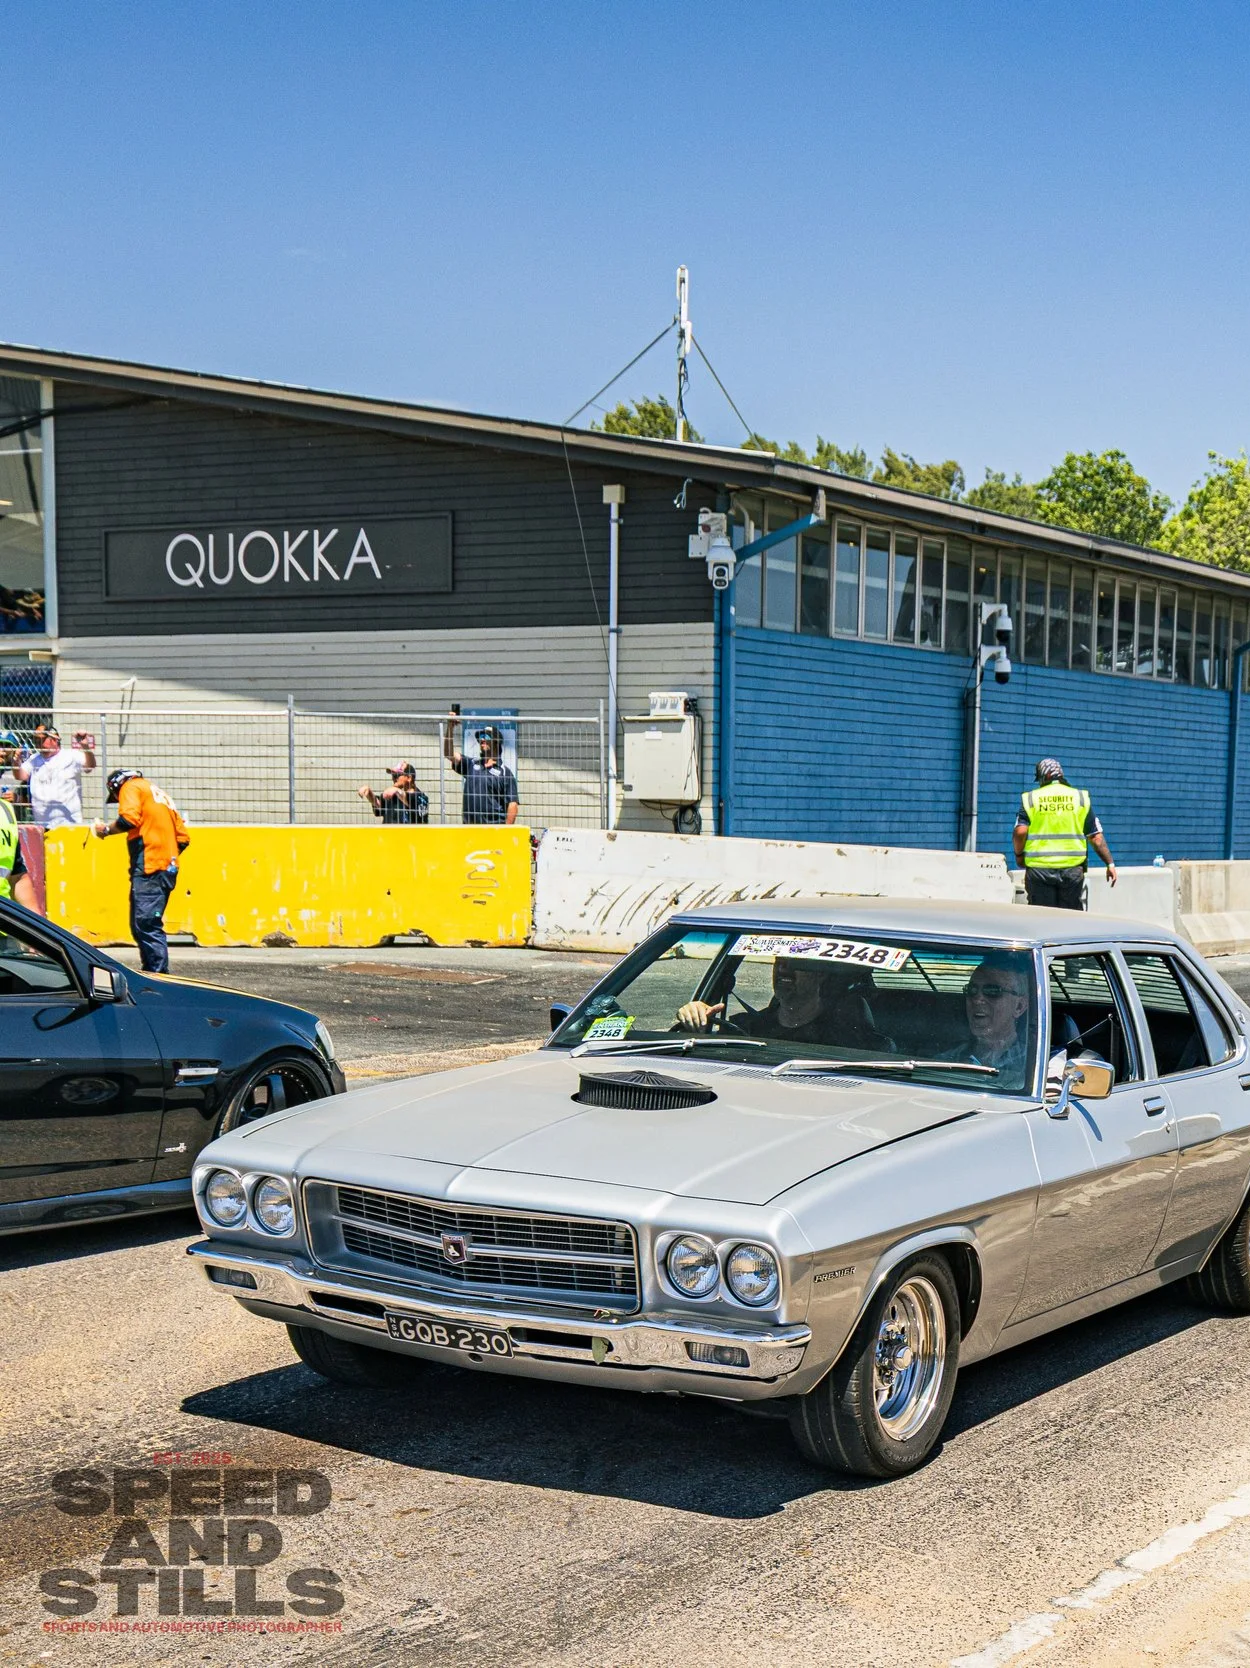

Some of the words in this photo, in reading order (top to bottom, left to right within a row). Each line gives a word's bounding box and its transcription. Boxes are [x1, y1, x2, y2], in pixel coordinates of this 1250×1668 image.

[165, 527, 382, 588] QUOKKA
[1038, 795, 1074, 803] SECURITY
[1039, 803, 1075, 812] NSRG
[818, 942, 890, 964] 2348
[588, 1028, 622, 1039] 2348
[813, 1265, 857, 1284] PREMIER
